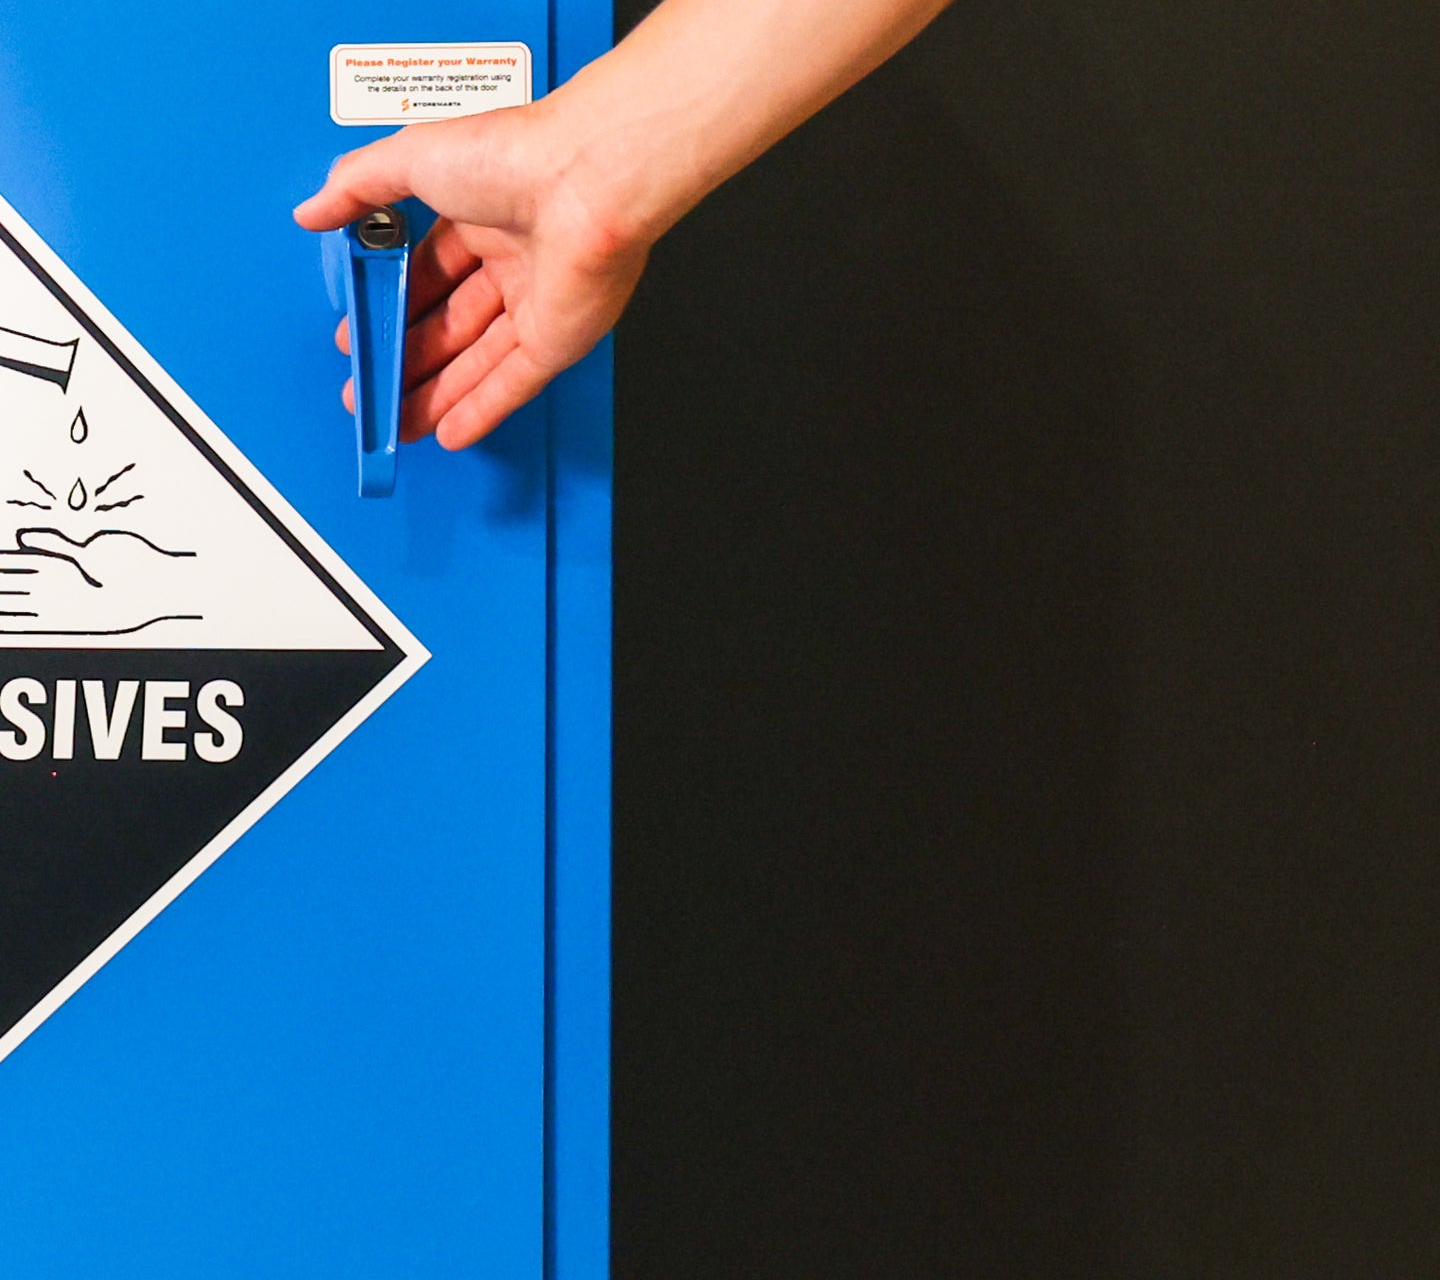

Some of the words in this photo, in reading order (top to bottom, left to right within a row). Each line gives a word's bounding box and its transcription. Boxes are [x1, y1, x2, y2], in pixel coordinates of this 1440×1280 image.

[346, 59, 383, 67] Please
[387, 58, 434, 68] Register
[438, 59, 462, 68] your
[466, 57, 518, 67] Warranty
[354, 75, 390, 83] Complete
[392, 75, 410, 84] your
[411, 74, 444, 83] warranty
[447, 74, 489, 83] registration
[491, 74, 511, 82] using
[421, 84, 433, 92] the
[435, 84, 453, 92] back
